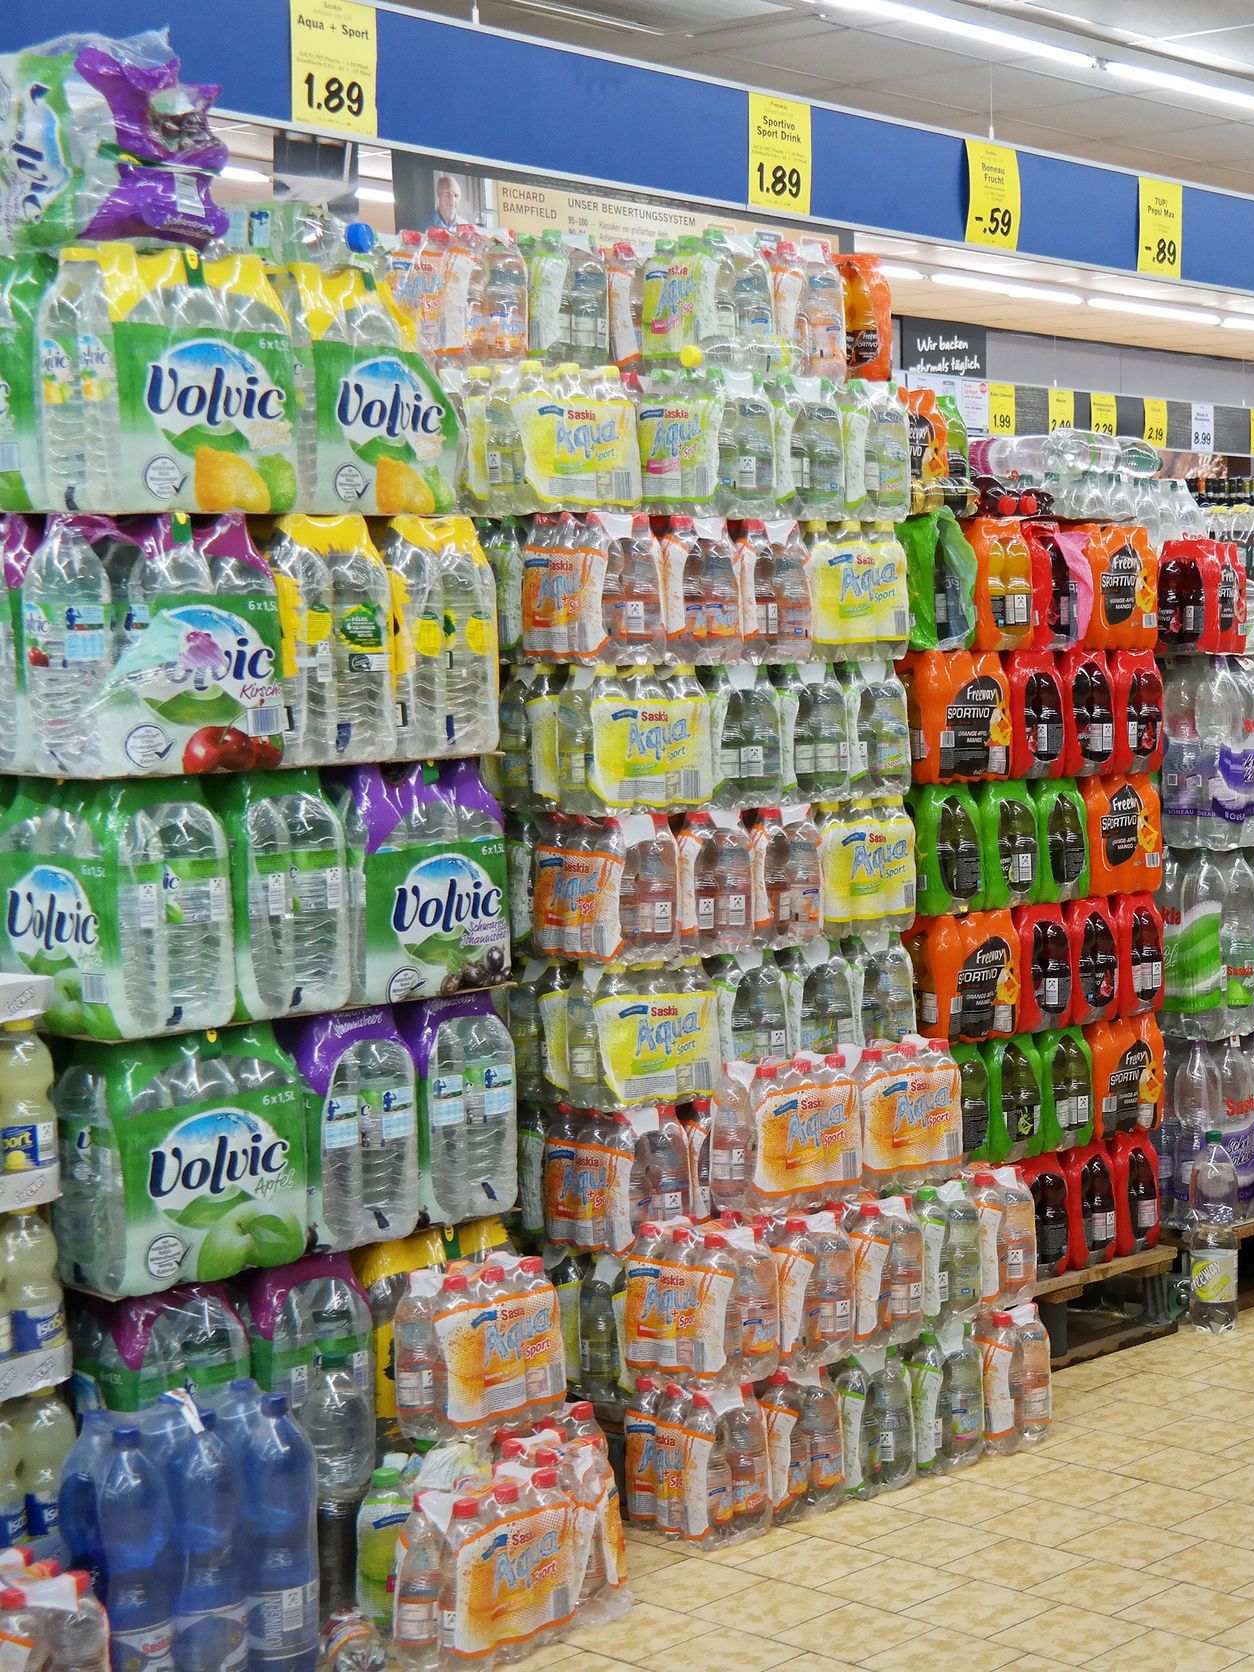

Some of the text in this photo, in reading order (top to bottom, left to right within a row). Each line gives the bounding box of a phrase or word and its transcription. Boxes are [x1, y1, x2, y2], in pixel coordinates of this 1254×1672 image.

[297, 14, 369, 40] Aqua + Sport
[304, 72, 364, 117] 1.89
[762, 115, 796, 131] Sportivo
[756, 126, 802, 145] Sport Drink
[981, 162, 1005, 175] Boneau
[757, 162, 801, 199] 1.89
[984, 173, 1005, 185] Frucht
[502, 186, 546, 203] RICHARD
[503, 202, 557, 220] BAMPFIELD
[567, 197, 696, 227] UNSER BEWERTUNGSSYSTEM
[1147, 205, 1175, 219] Pepsi Max
[975, 207, 1012, 237] -.59
[1145, 238, 1177, 266] -.89
[917, 335, 969, 352] Wir backen
[909, 354, 980, 376] mehrmals täglich
[147, 364, 285, 427] Volvic
[338, 380, 444, 438] Volvic
[567, 409, 597, 422] Saskia
[993, 414, 1011, 429] 1.99
[556, 420, 620, 459] Aqua
[1148, 427, 1163, 442] 2.19
[1193, 431, 1211, 446] 8.99
[840, 561, 898, 601] Aqua
[1101, 573, 1138, 588] SPORTIVO
[966, 686, 997, 702] Freeway
[947, 707, 991, 721] SPORTIVO
[627, 719, 691, 761] Aqua
[1101, 814, 1139, 830] SPORTIVO
[851, 838, 909, 881] Aqua
[885, 863, 907, 879] Sport
[393, 878, 502, 933] Volvic
[7, 889, 99, 951] Volvic
[1226, 966, 1254, 977] Saskia
[651, 1004, 679, 1018] Saskia
[637, 1010, 701, 1054] Aqua
[262, 1091, 296, 1106] 6x1,5L
[894, 1086, 952, 1132] Aqua
[787, 1103, 847, 1153] Aqua
[928, 1112, 950, 1128] Sport
[824, 1129, 846, 1147] Sport
[149, 1132, 290, 1199] Volvic
[254, 1168, 295, 1198] Apfel
[483, 1308, 552, 1368] Aqua
[525, 1337, 551, 1359] Sport
